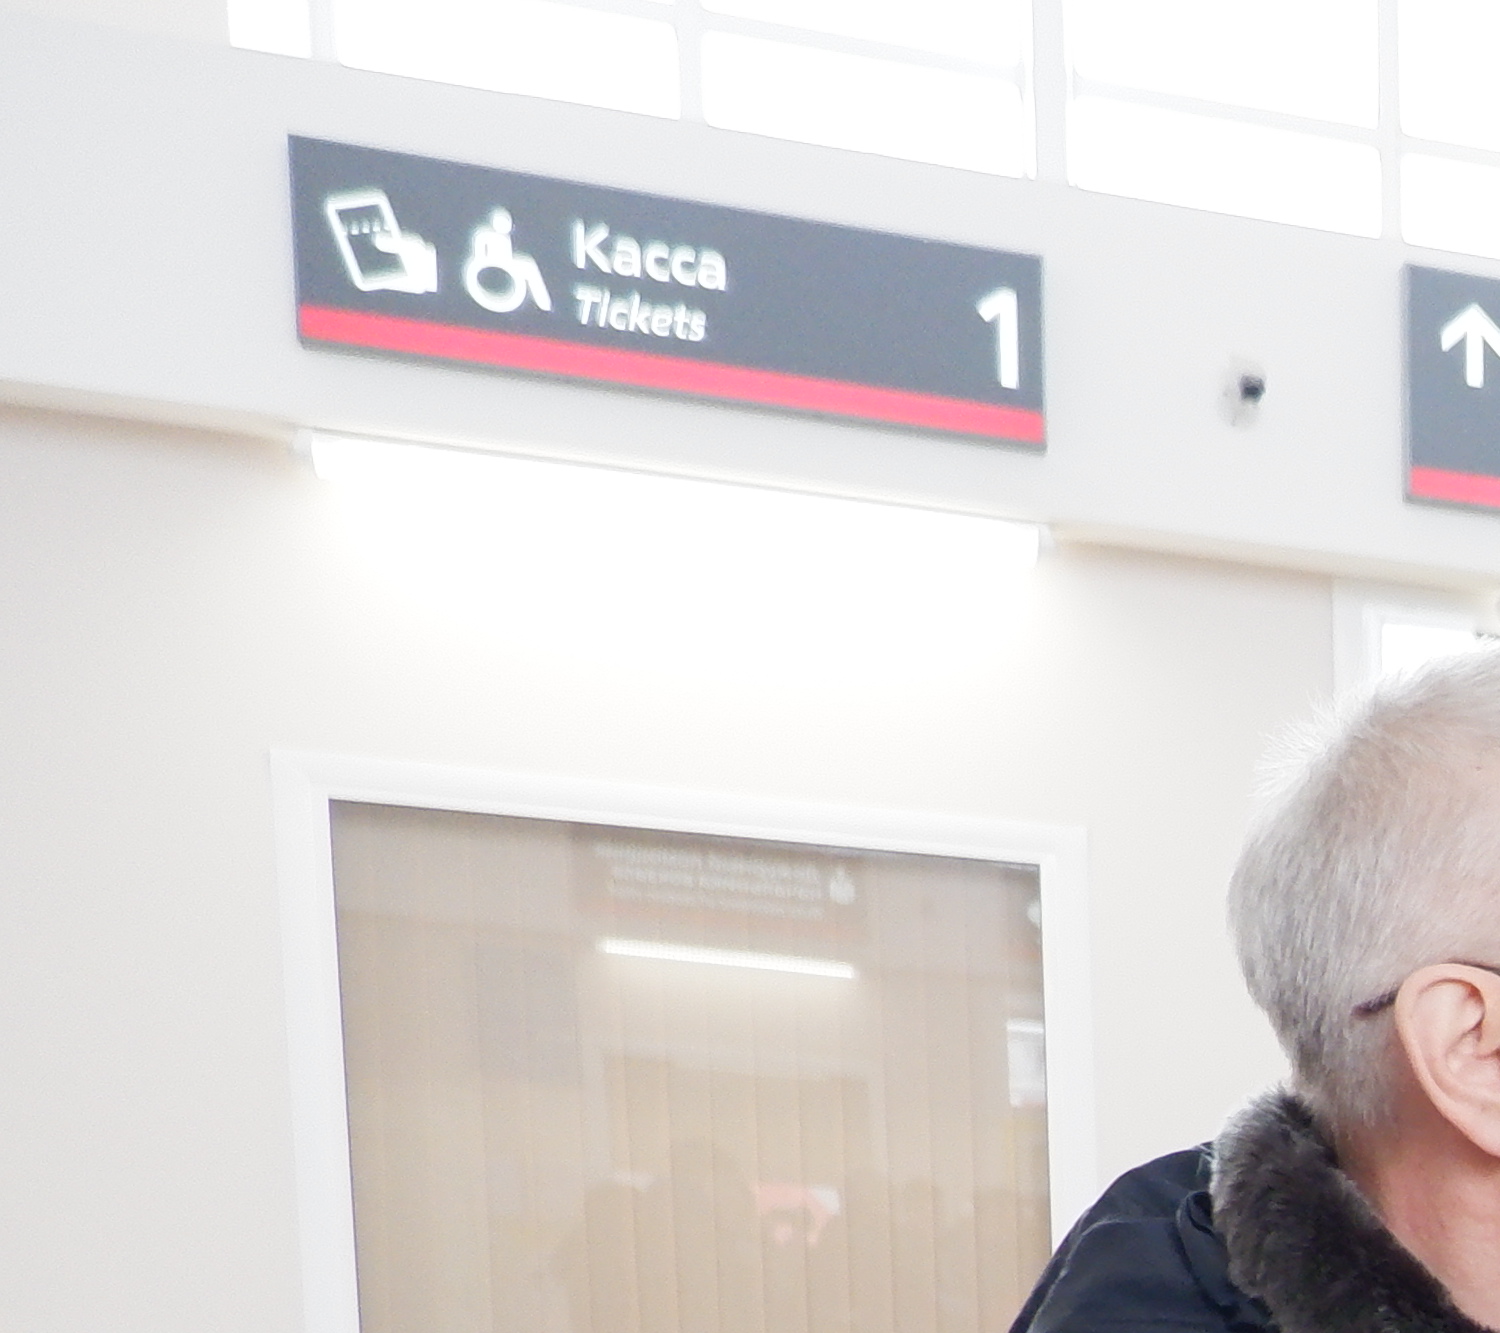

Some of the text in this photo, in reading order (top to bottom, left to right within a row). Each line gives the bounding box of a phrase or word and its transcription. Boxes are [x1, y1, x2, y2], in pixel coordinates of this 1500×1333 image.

[572, 217, 728, 292] Касса
[575, 287, 708, 342] Tickets
[976, 286, 1020, 390] 1
